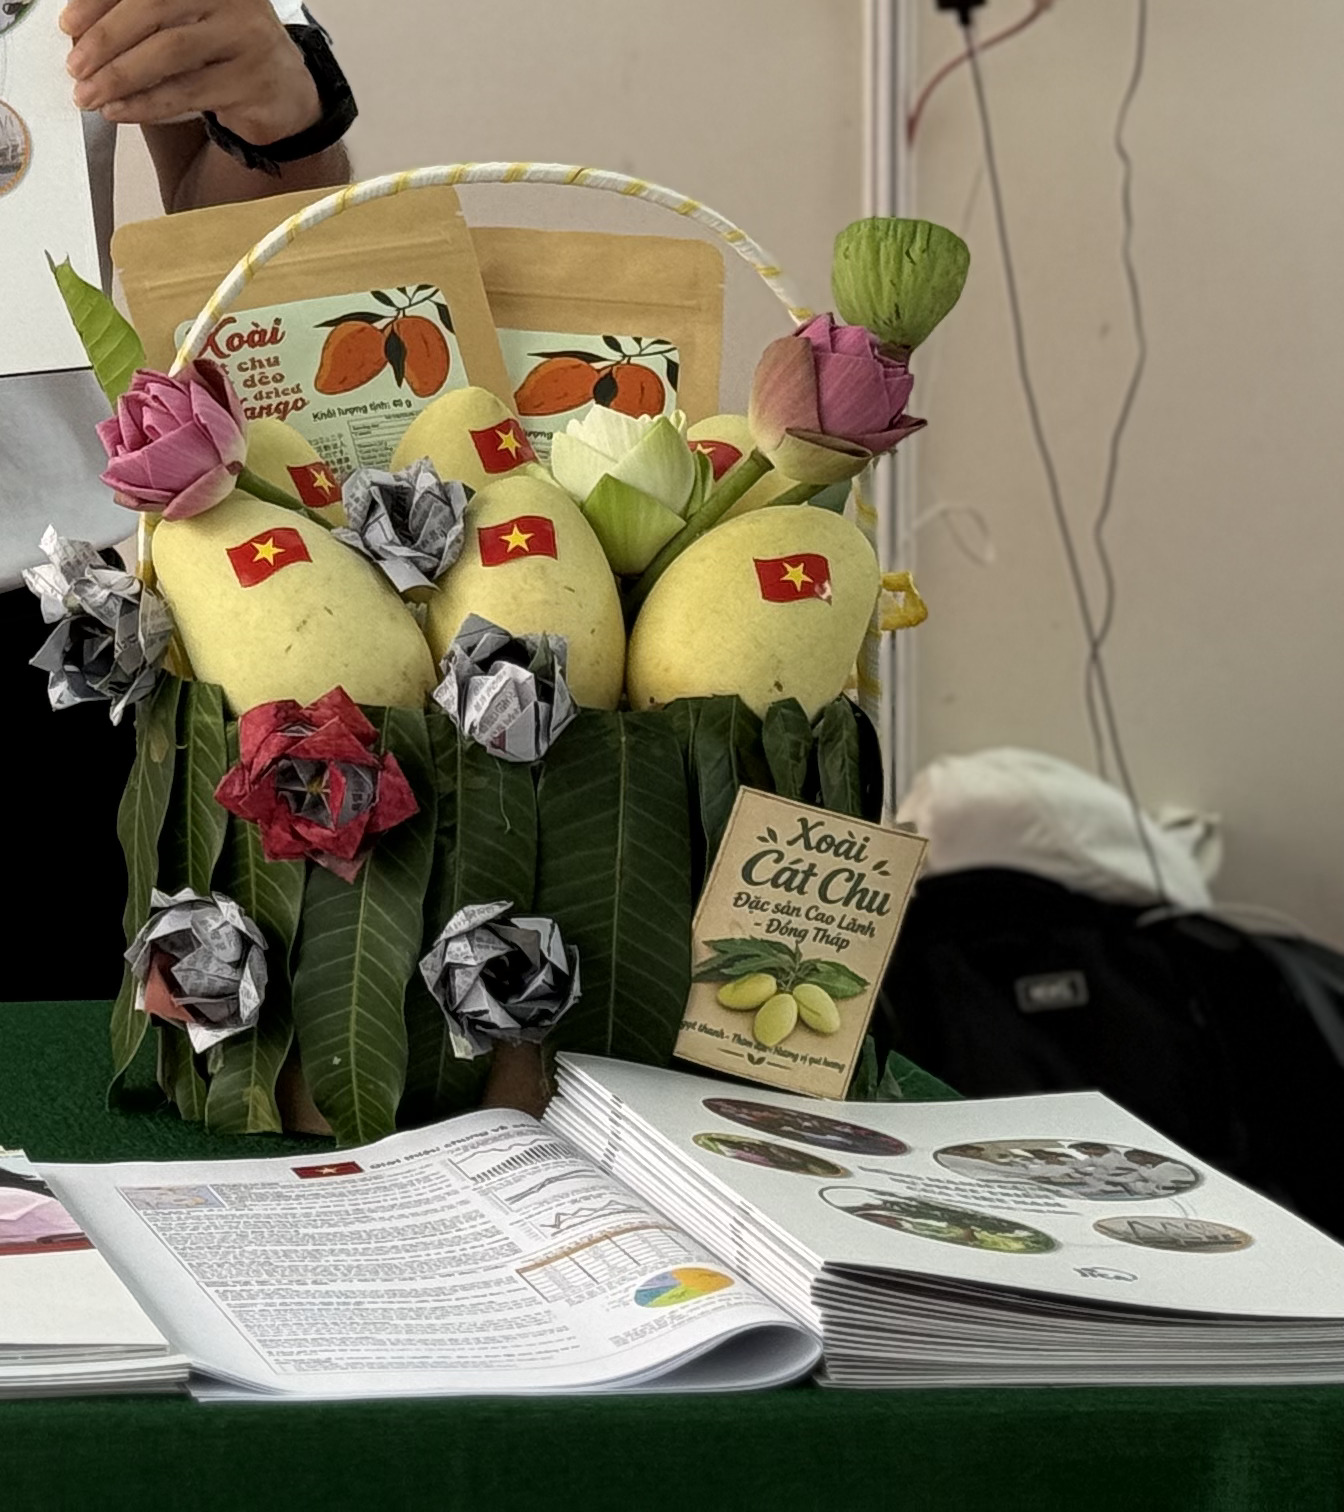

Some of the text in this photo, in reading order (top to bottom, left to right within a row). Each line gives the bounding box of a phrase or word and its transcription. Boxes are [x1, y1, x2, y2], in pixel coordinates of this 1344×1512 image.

[236, 355, 282, 374] chu
[242, 395, 310, 422] ango
[786, 816, 871, 864] Xoài
[741, 849, 891, 917] Cát Chu
[732, 891, 771, 914] Đặc
[805, 904, 835, 926] Cao
[836, 914, 876, 938] Lãnh
[812, 926, 851, 953] Tháp
